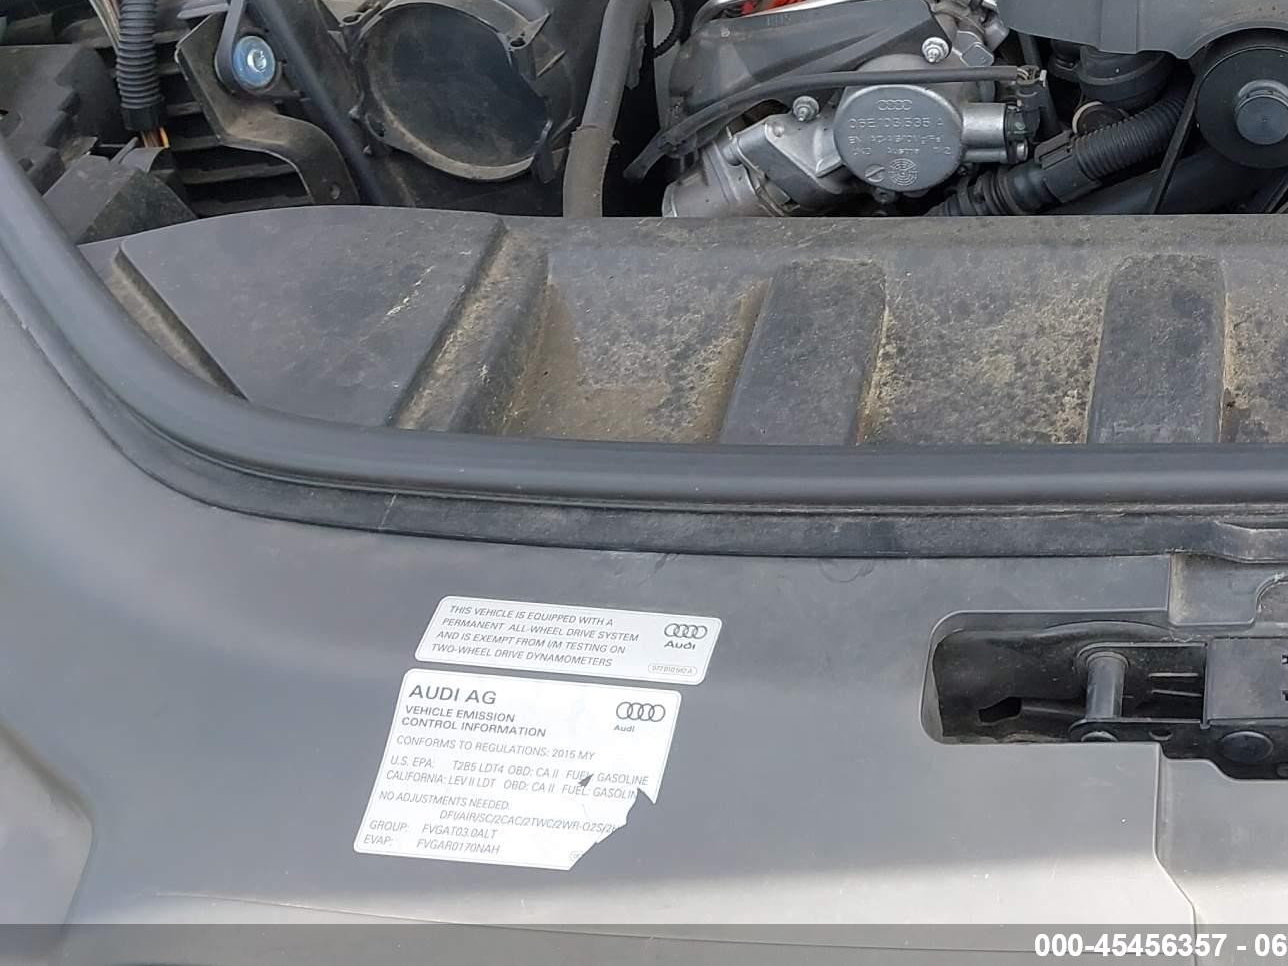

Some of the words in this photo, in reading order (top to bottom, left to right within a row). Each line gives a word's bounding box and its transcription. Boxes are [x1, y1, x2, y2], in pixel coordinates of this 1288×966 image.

[450, 605, 472, 614] THIS
[474, 607, 512, 618] VEHICLE
[515, 611, 525, 619] IS
[527, 612, 577, 624] EQUIPPED
[579, 615, 605, 626] WITH
[606, 618, 614, 627] A
[441, 617, 505, 630] PERMANENT
[508, 623, 563, 636] ALL-WHEEL
[566, 628, 597, 639] DRIVE
[597, 631, 640, 642] SYSTEM
[436, 631, 459, 640] AND
[461, 633, 471, 641] IS
[472, 633, 515, 645] EXEMPT
[515, 636, 545, 648] FROM
[547, 640, 562, 650] I/M
[565, 641, 608, 653] TESTING
[609, 645, 626, 654] ON
[663, 640, 696, 650] Audi
[431, 643, 492, 657] TWO-WHEEL
[494, 649, 524, 659] DRIVE
[525, 652, 613, 667] DYNAMOMETERS
[408, 684, 461, 702] AUDI
[464, 689, 497, 705] AG
[405, 705, 453, 718] VEHICLE
[456, 709, 515, 723] EMISSION
[401, 717, 458, 730] CONTROL
[460, 722, 547, 738] INFORMATION
[613, 724, 635, 733] Audi
[396, 735, 457, 749] CONFORMS
[459, 740, 473, 751] TO
[578, 750, 596, 761] MY
[535, 767, 550, 778] CA
[597, 772, 649, 786] GASOLINE
[448, 775, 469, 786] LEV
[476, 777, 497, 788] LDT
[532, 782, 545, 792] CA
[593, 787, 636, 800] GASOLIN
[379, 791, 395, 801] NO
[395, 792, 467, 807] ADJUSTMENTS
